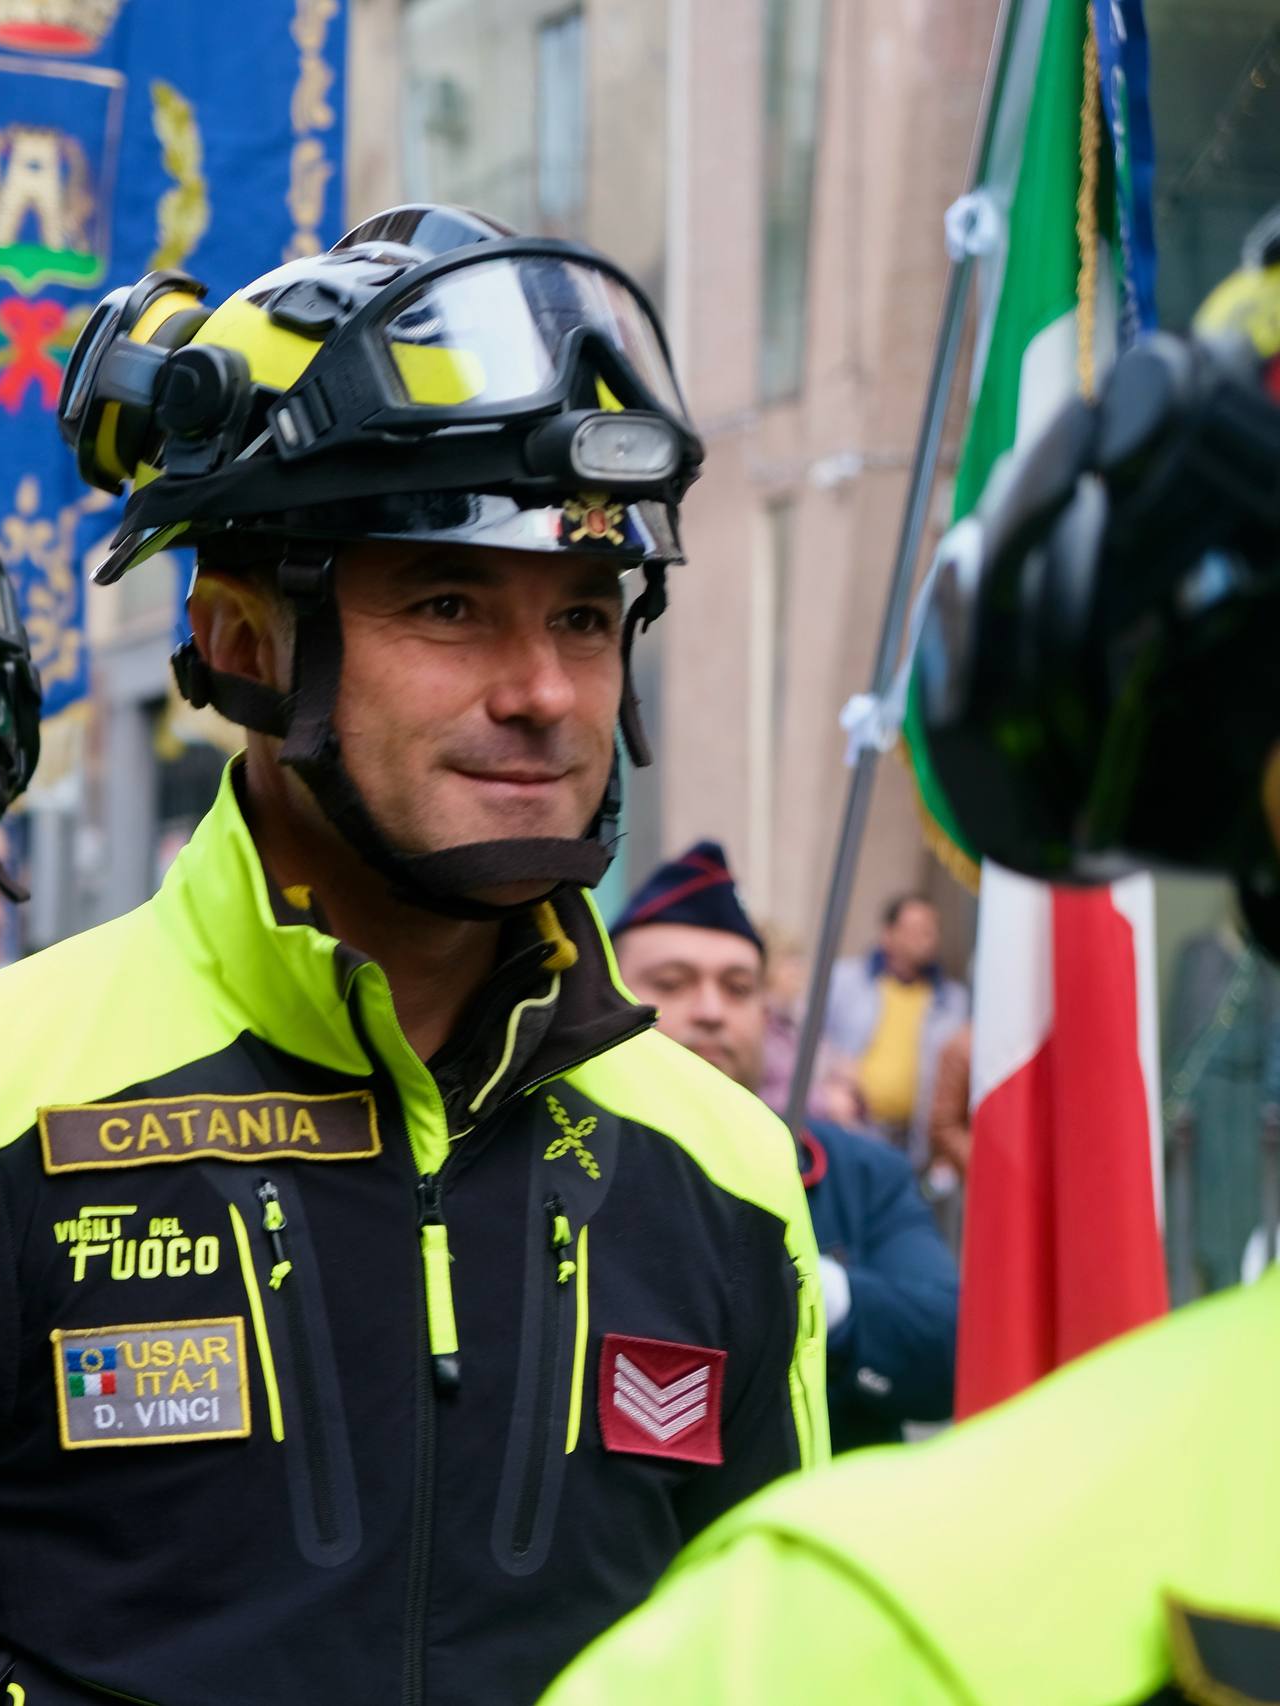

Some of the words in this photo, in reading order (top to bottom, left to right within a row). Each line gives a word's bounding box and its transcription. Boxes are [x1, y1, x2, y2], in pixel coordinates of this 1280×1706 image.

[99, 1106, 320, 1153] CATANIA
[53, 1216, 122, 1244] VIGILI
[148, 1217, 184, 1238] DEL
[69, 1236, 220, 1283] FUOCO
[124, 1335, 233, 1369] USAR
[135, 1367, 220, 1398] ITA-1
[94, 1405, 124, 1430] D.
[136, 1397, 221, 1428] VINCI
